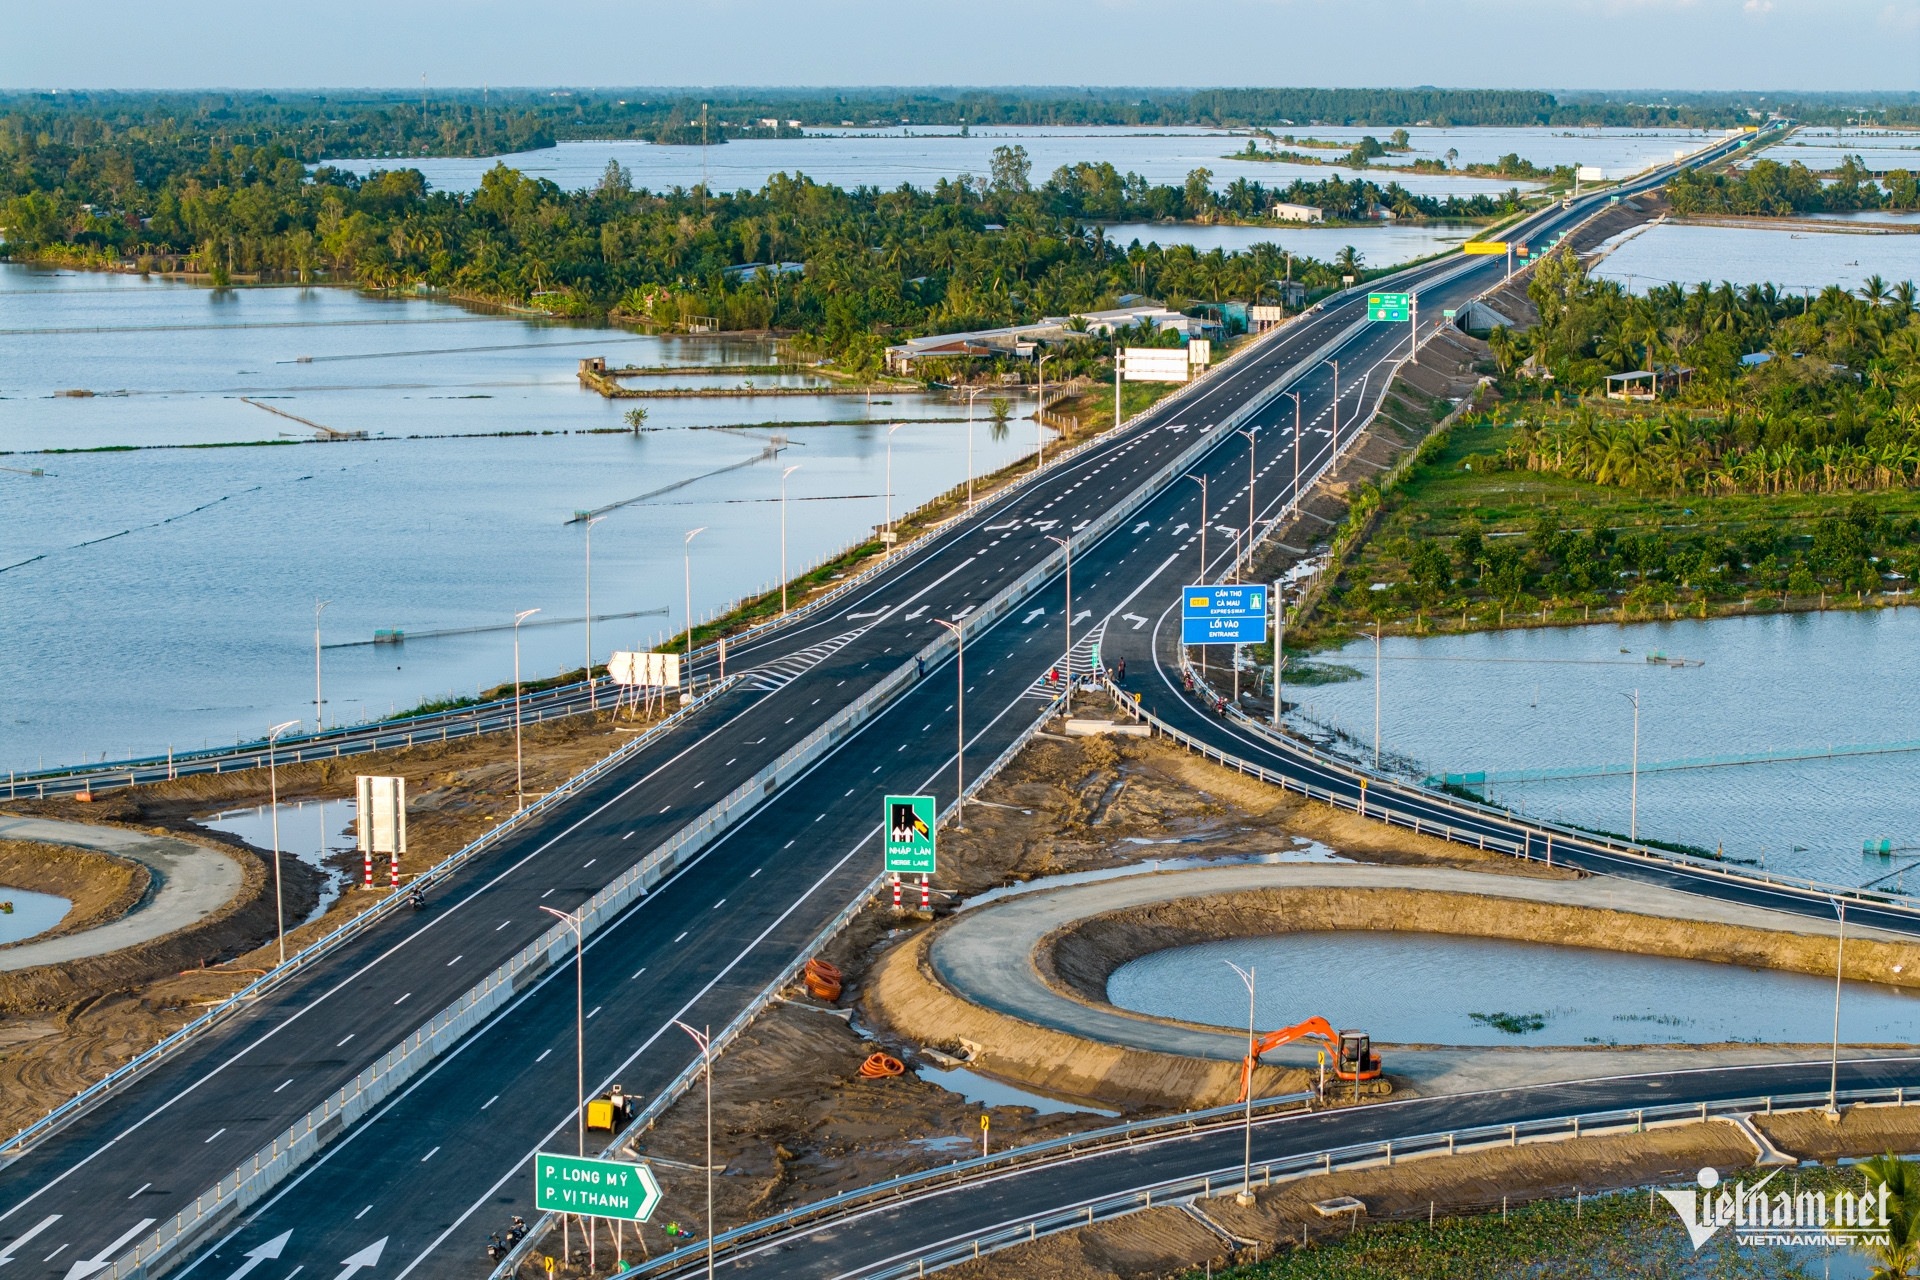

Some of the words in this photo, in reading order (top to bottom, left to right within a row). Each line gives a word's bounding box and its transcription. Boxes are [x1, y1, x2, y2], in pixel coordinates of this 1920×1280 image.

[1209, 618, 1222, 629] LỐI
[1223, 620, 1239, 628] VÀO
[889, 846, 911, 855] NHẬP
[914, 846, 931, 855] LÀN
[546, 1165, 557, 1179] P.
[563, 1167, 600, 1184] LONG
[606, 1171, 628, 1187] MỸ
[546, 1187, 557, 1200] P.
[563, 1189, 577, 1206] VỊ
[580, 1191, 629, 1209] THANH
